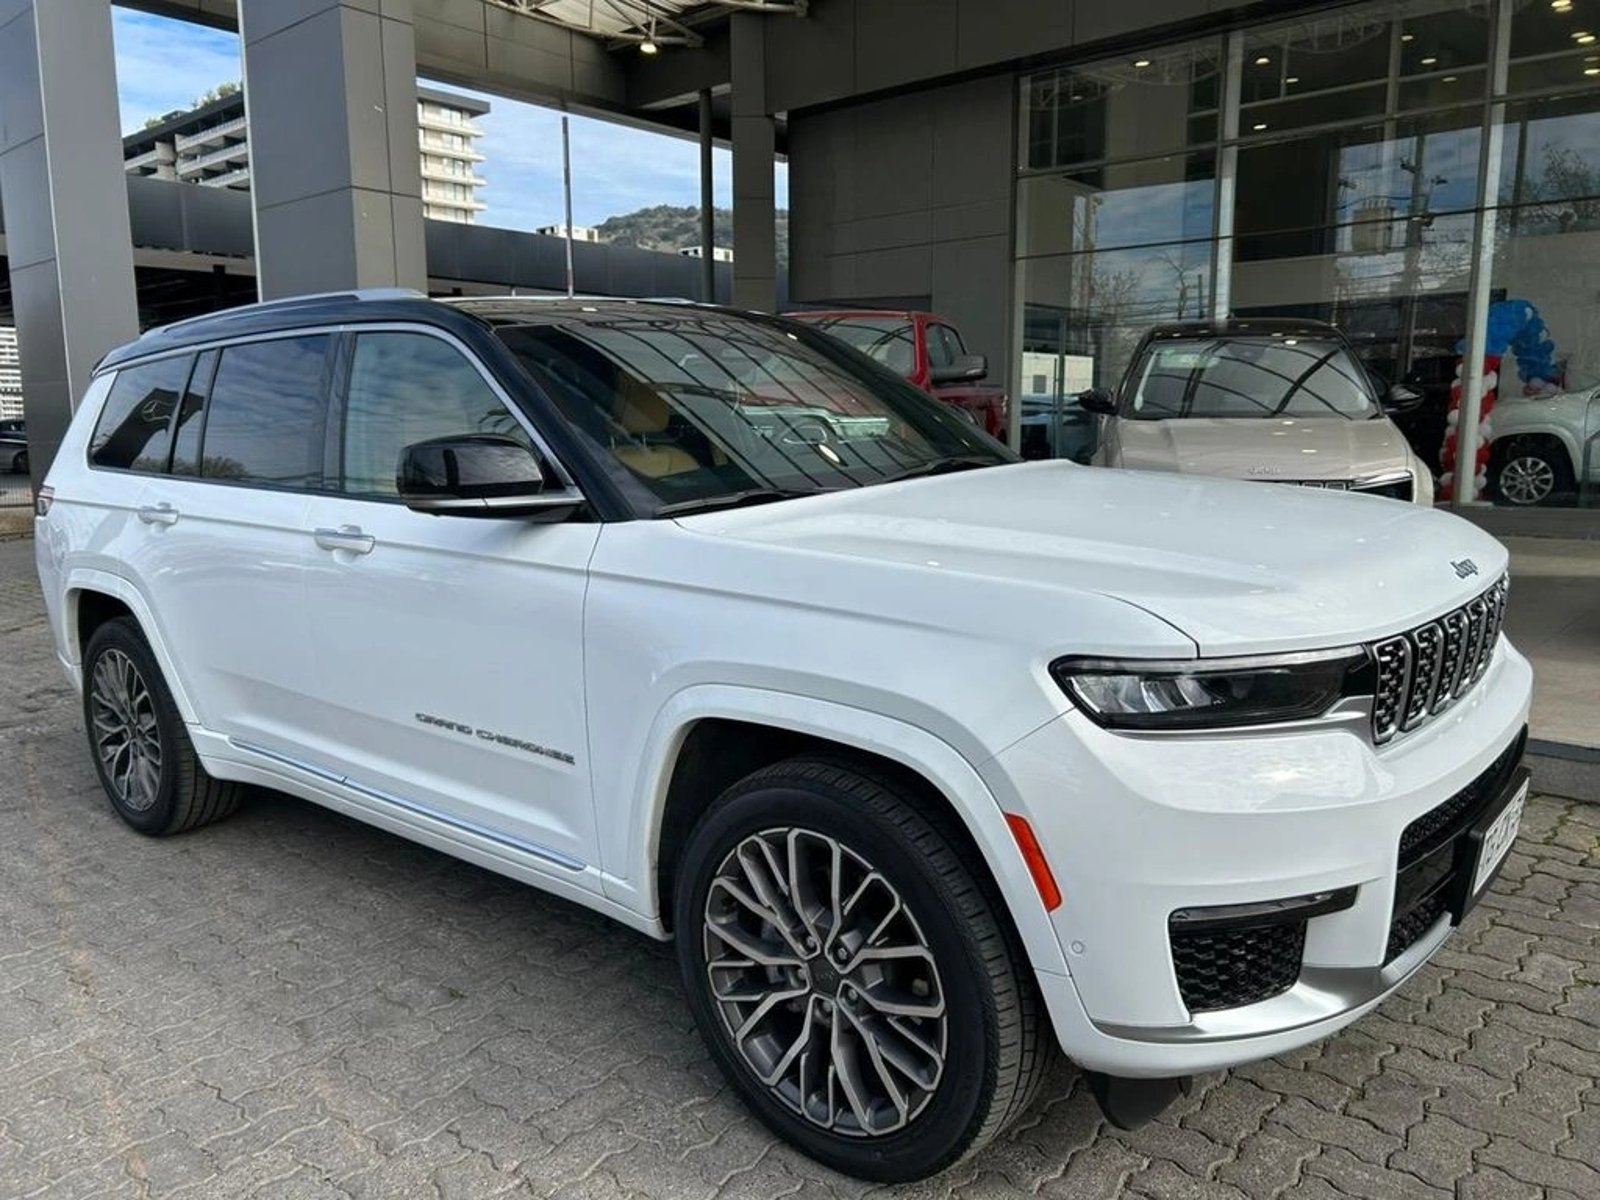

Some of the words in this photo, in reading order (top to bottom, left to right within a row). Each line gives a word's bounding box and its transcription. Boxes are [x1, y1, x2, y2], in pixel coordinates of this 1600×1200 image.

[1450, 558, 1478, 579] Jeep
[415, 712, 473, 735] GRAND
[476, 729, 575, 765] CHEROKEE
